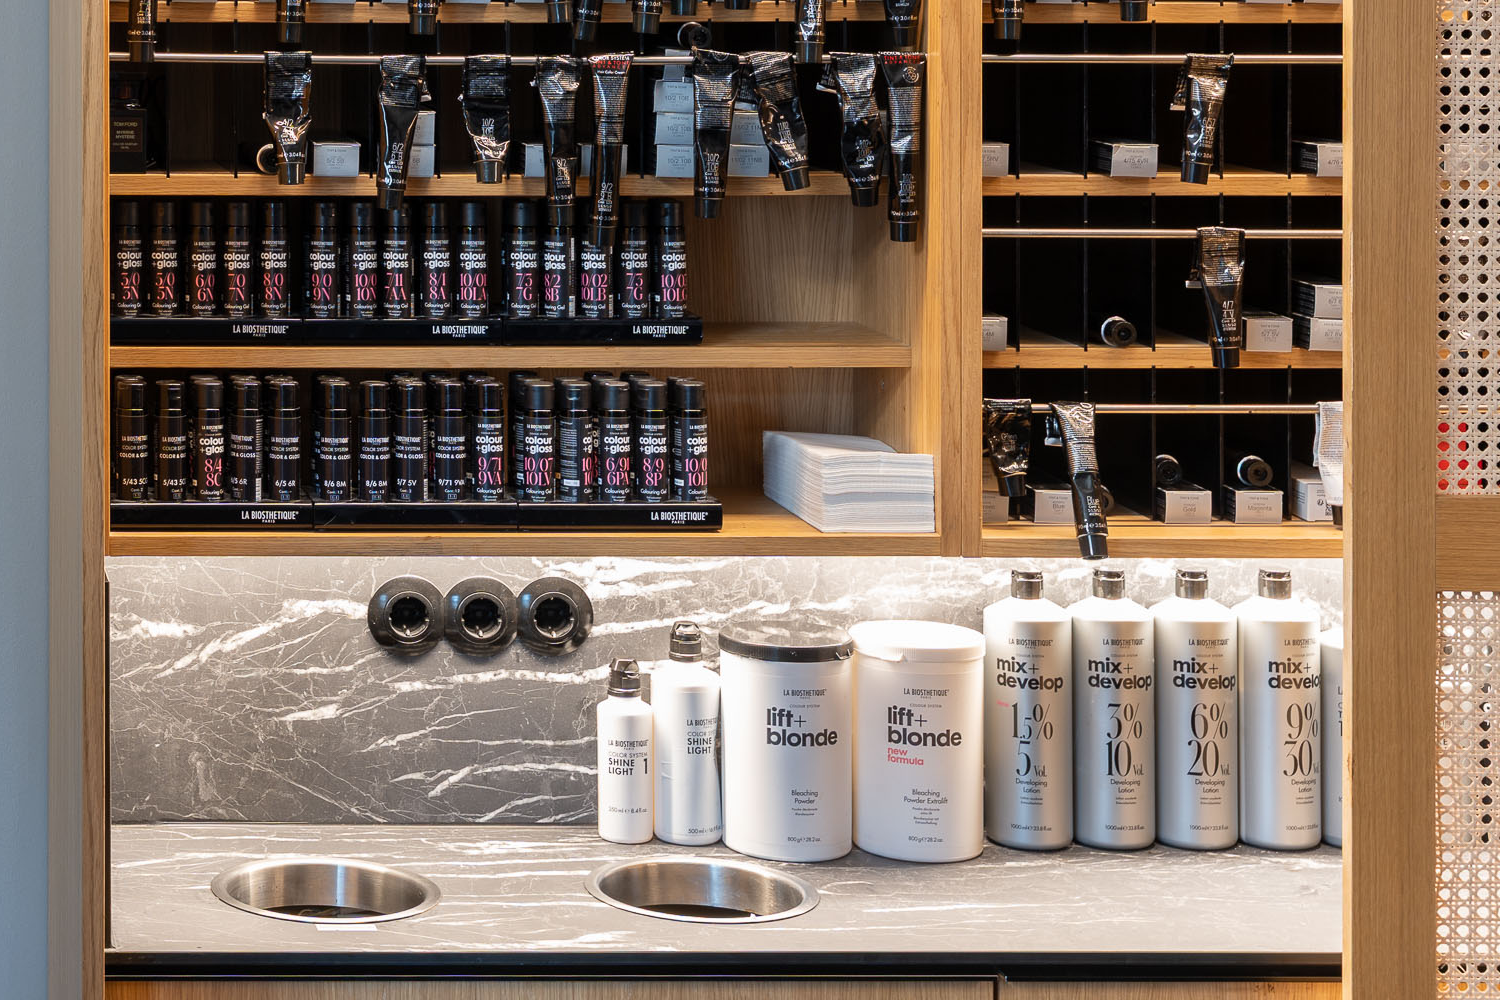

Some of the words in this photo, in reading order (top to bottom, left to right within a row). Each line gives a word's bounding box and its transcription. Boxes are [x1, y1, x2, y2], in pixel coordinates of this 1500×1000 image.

[195, 274, 215, 288] 6/0
[264, 273, 284, 287] 8/0
[312, 273, 332, 287] 9/0
[430, 272, 446, 286] 8/1
[197, 288, 214, 302] 6N
[228, 288, 244, 301] 7N
[265, 287, 282, 300] 8N
[313, 288, 330, 301] 9N
[385, 287, 406, 300] 7AA
[430, 286, 446, 300] 8A
[516, 287, 532, 300] 7G
[544, 288, 559, 302] 8B
[626, 287, 643, 300] 7G
[433, 326, 440, 334] LA
[633, 326, 640, 334] LA
[643, 458, 664, 472] 8/9
[478, 472, 502, 485] 9VA
[607, 472, 629, 485] 6PA
[645, 472, 662, 486] 8P
[651, 512, 659, 520] LA
[997, 673, 1064, 693] develop
[1088, 673, 1152, 691] develop
[1173, 673, 1236, 691] develop
[1107, 703, 1142, 740] 3%
[1191, 703, 1228, 740] 6%
[767, 729, 837, 747] blonde
[888, 726, 962, 747] blonde
[887, 747, 908, 756] new
[608, 758, 634, 767] SHINE
[887, 755, 924, 765] formula
[1016, 741, 1031, 777] 5
[1106, 741, 1131, 776] 10
[1187, 741, 1219, 776] 20
[1283, 741, 1312, 776] 30
[608, 767, 633, 775] LIGHT
[643, 759, 648, 774] 1
[1015, 778, 1047, 788] Developing
[1110, 778, 1141, 788] Developing
[1195, 778, 1225, 788] Developing
[1291, 778, 1316, 788] Developing
[791, 789, 818, 798] Bleaching
[912, 789, 940, 798] Bleaching
